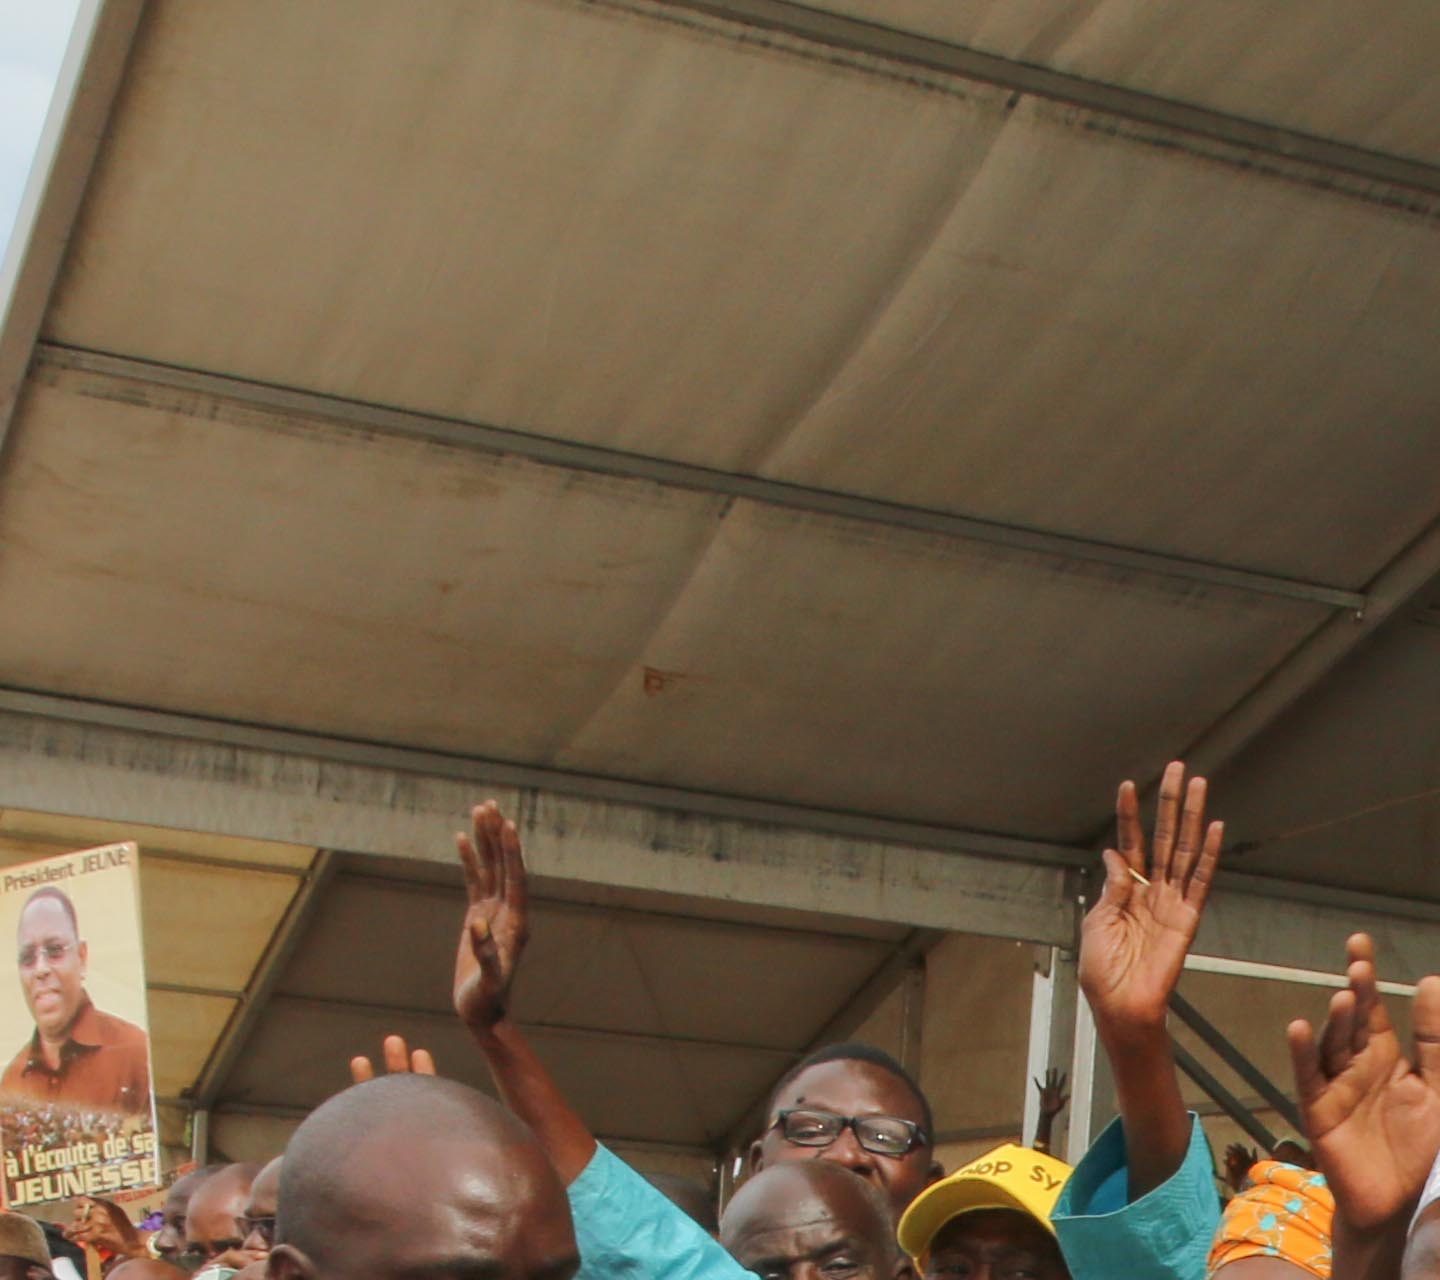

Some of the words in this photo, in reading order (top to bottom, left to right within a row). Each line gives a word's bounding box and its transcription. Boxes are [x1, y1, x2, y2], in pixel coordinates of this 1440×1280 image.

[4, 862, 75, 892] Président
[80, 847, 129, 874] JEUNE
[6, 1151, 19, 1178] à
[22, 1141, 99, 1174] l'écoute
[103, 1129, 129, 1160] de
[132, 1132, 154, 1156] sa
[10, 1158, 155, 1207] JEUNESSE
